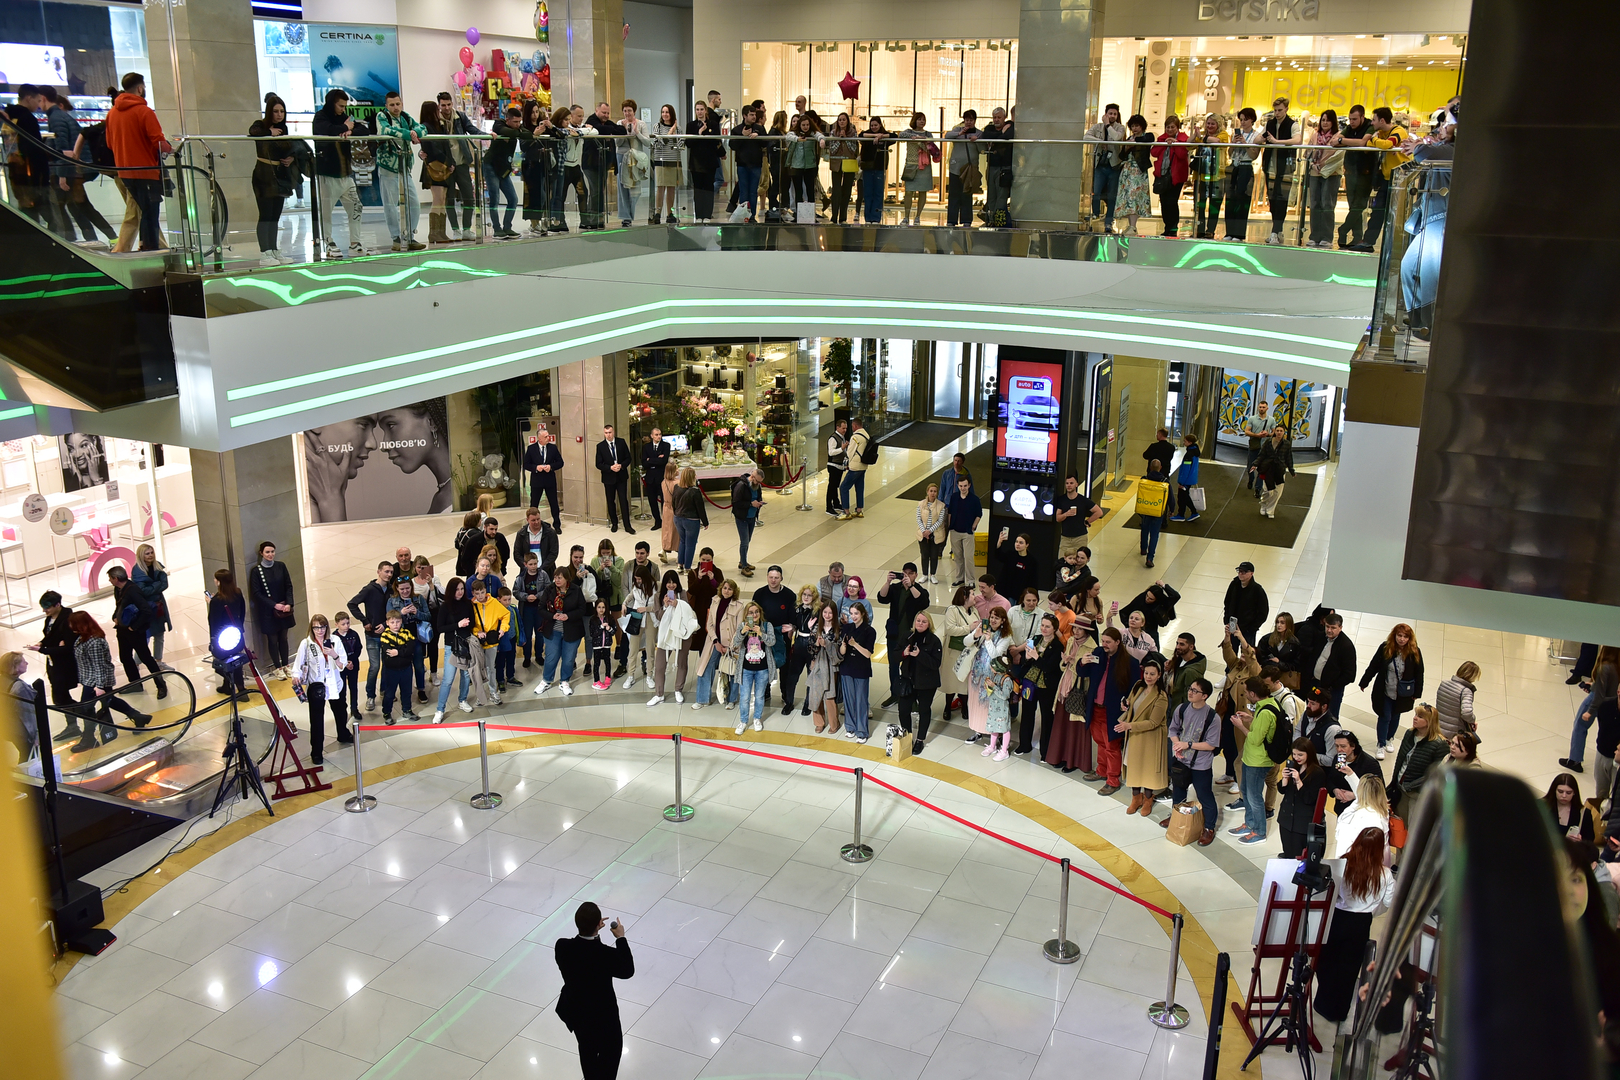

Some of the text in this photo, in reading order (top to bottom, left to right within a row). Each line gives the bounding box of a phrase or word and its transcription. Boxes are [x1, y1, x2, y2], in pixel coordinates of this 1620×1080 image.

[1198, 0, 1319, 21] Bershka
[320, 32, 373, 40] CERTINA
[1204, 61, 1221, 101] BSK
[1271, 77, 1411, 108] Bershka
[328, 438, 427, 453] БУДЬ ЛЮБОВ'Ю
[1137, 497, 1159, 507] Glovo
